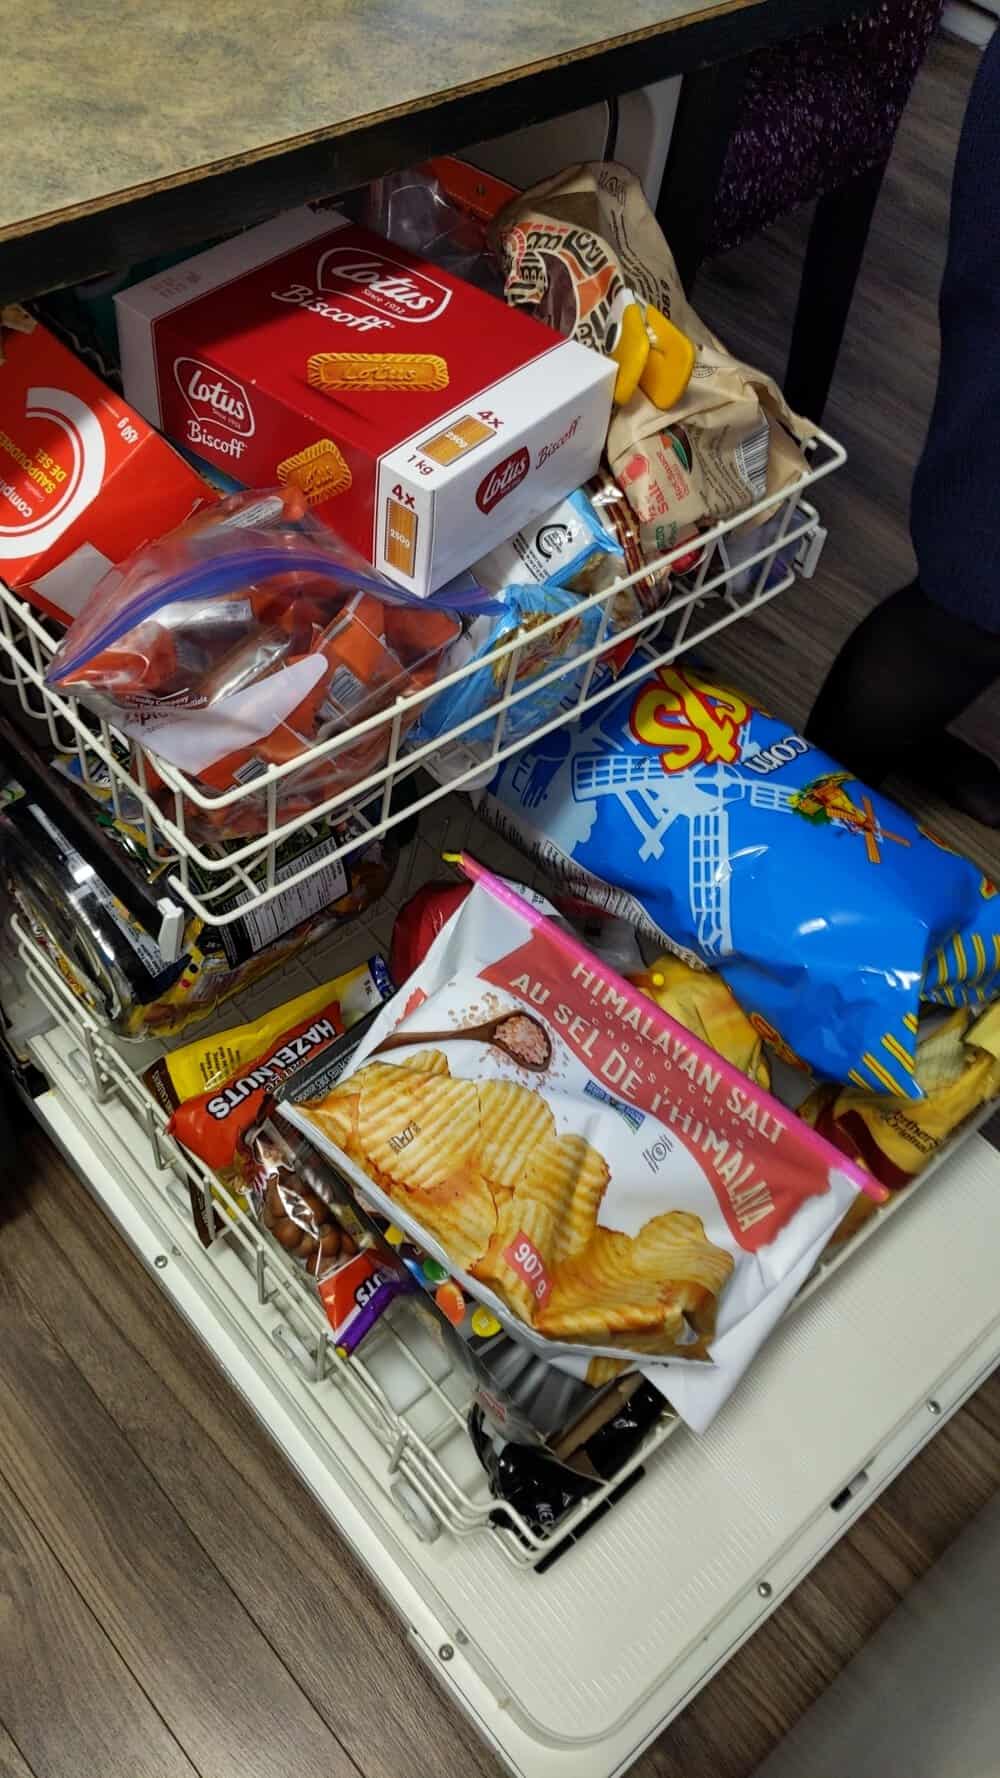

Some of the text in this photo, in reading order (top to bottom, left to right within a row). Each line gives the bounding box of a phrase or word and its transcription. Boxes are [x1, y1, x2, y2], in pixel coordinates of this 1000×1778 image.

[271, 284, 392, 331] Biscoff
[332, 262, 435, 309] Lotus
[188, 370, 245, 420] Lotus
[187, 420, 247, 459] Biscoff
[49, 465, 67, 482] DE
[416, 460, 434, 476] kg
[483, 457, 526, 504] Lotus
[508, 974, 550, 1005] AU
[554, 1003, 600, 1059] SEL
[601, 1048, 643, 1099] DE
[571, 962, 722, 1095] HIMALAYAN
[726, 1086, 787, 1144] SALT
[207, 1018, 336, 1119] HAZELNUTS
[512, 1243, 546, 1299] 907 g
